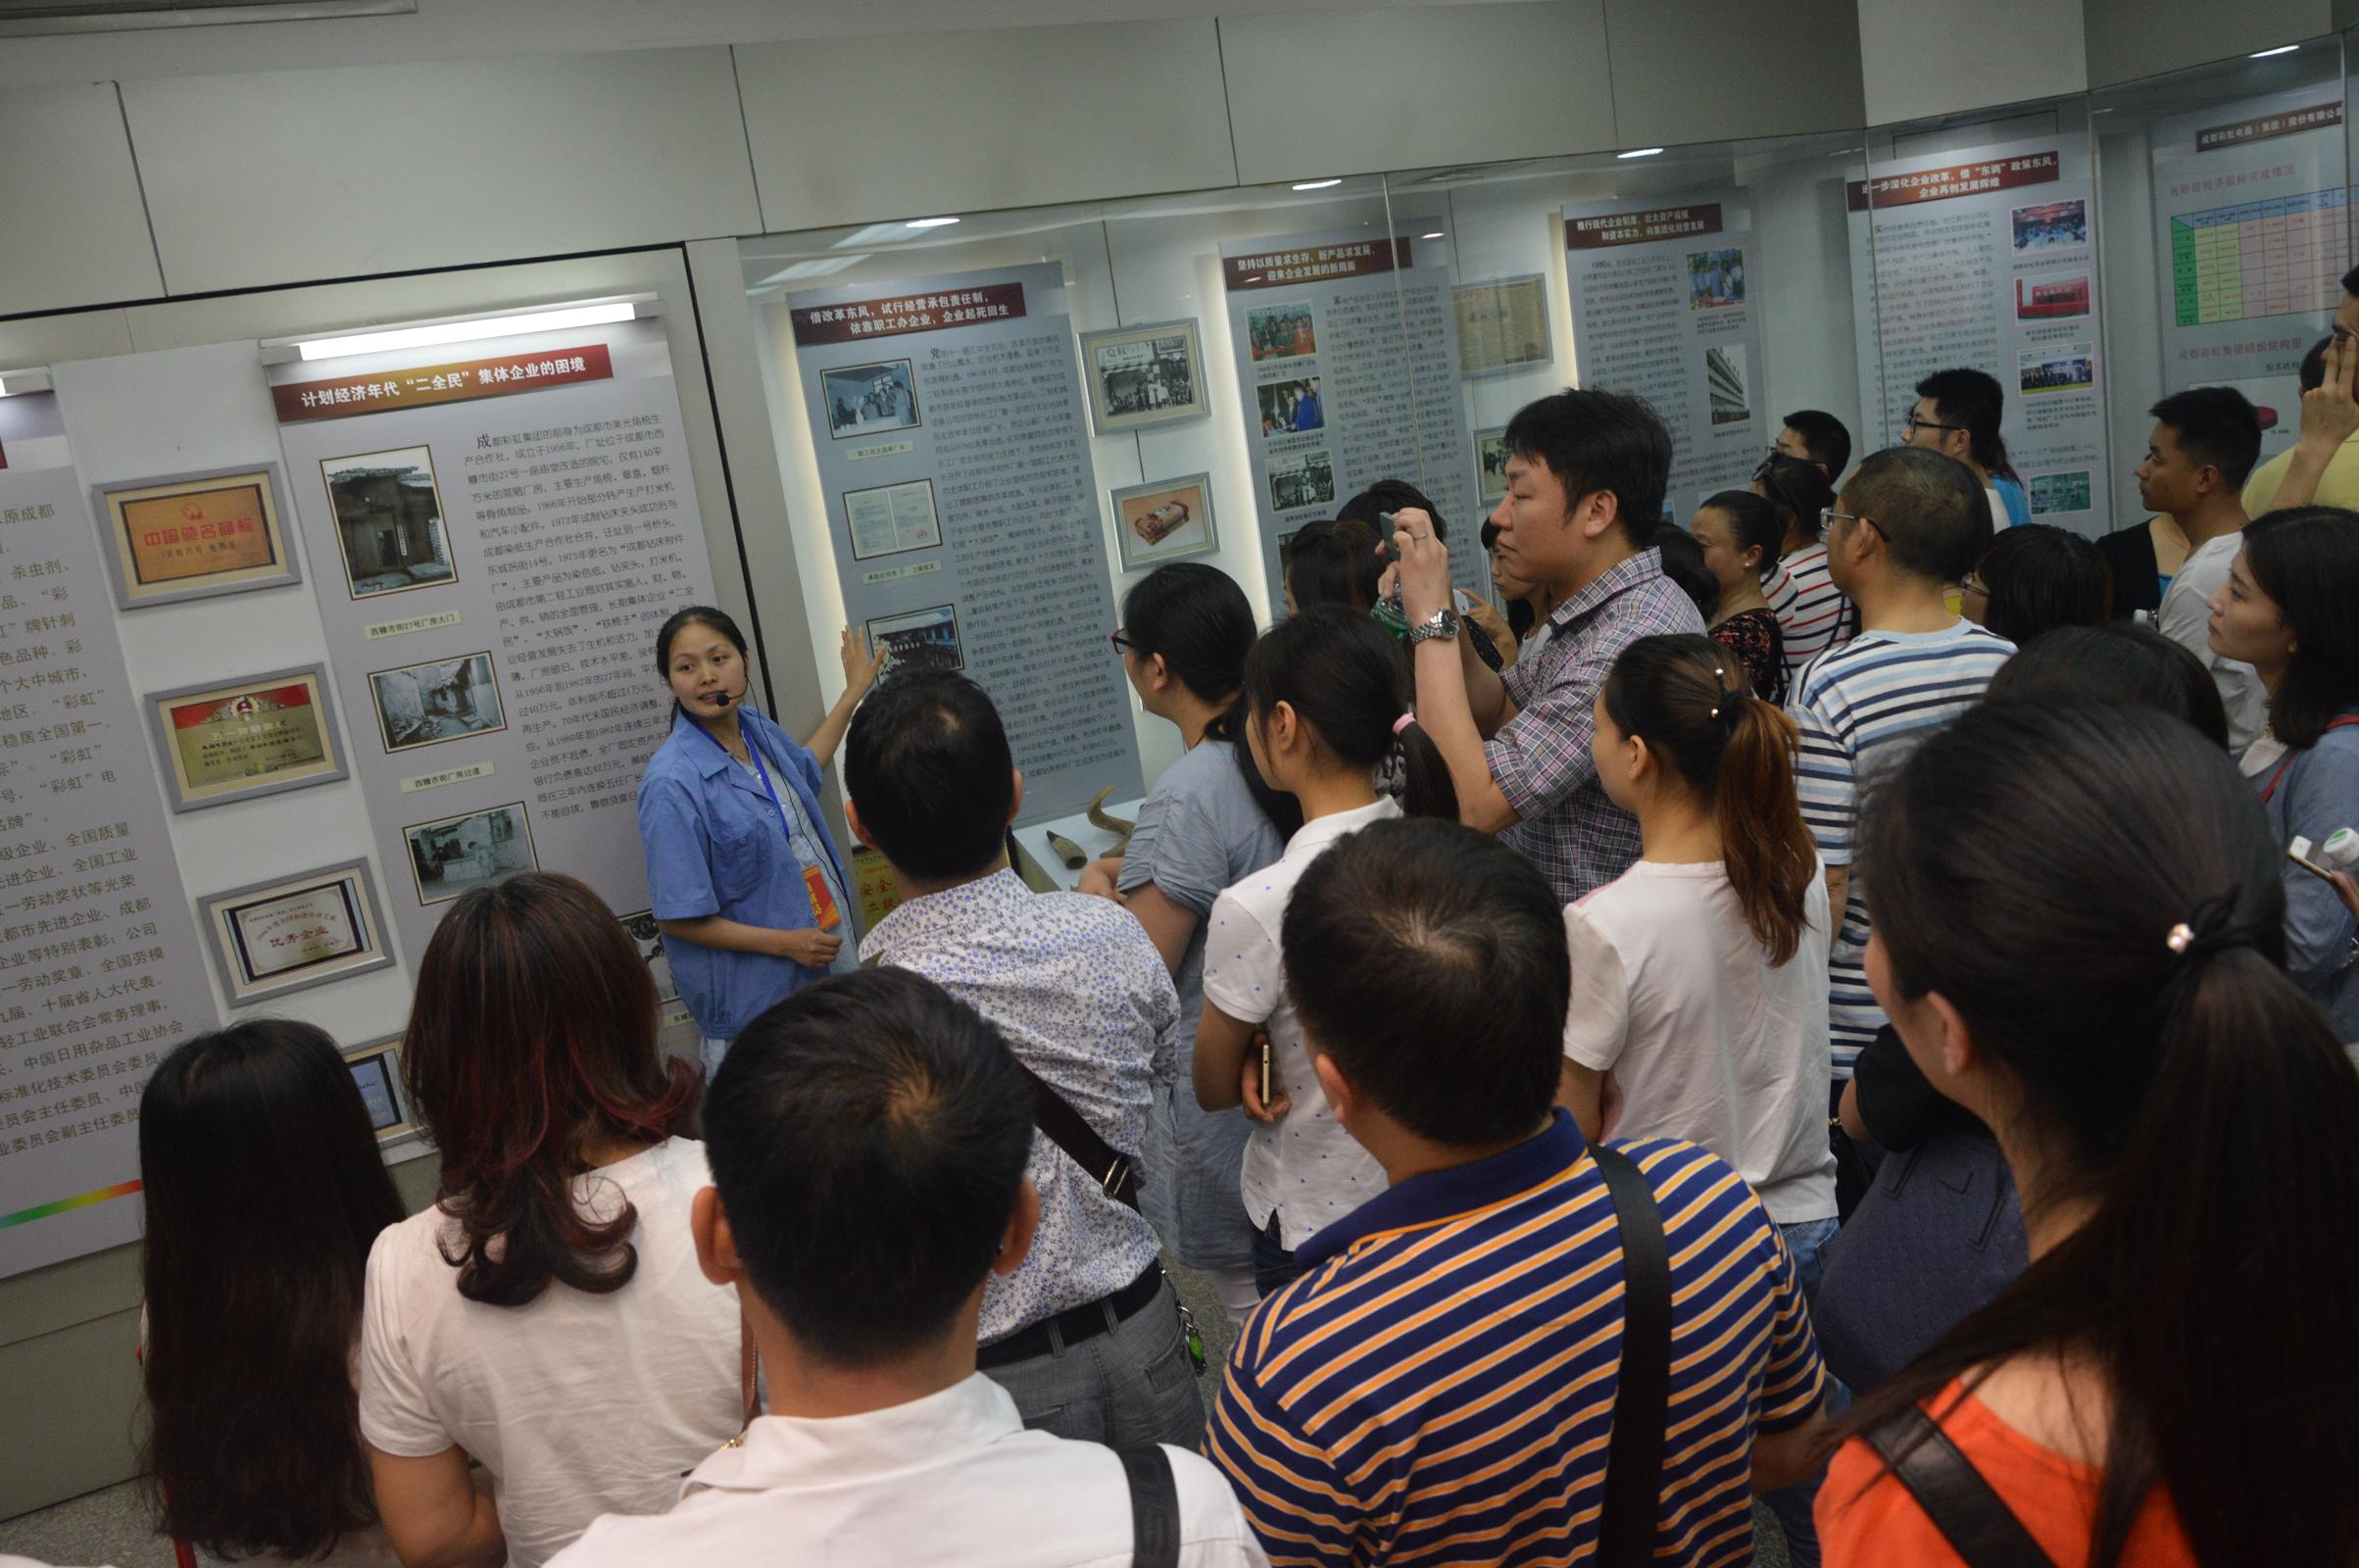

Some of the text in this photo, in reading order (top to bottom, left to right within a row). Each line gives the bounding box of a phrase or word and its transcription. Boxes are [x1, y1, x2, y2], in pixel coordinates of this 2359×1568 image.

[850, 305, 1009, 335] 依靠职工办企业，企业起死回生
[301, 356, 586, 409] 计划经济年代“二全民”集体企业的困境
[0, 504, 55, 525] 原成都
[143, 517, 254, 548] 中国驰名商标
[370, 613, 455, 637] 西糠市街27号厂房大门
[0, 874, 137, 916] 一劳动奖状等光荣
[269, 925, 329, 949] 优秀企业
[0, 947, 165, 997] 一劳动奖章、全国劳模
